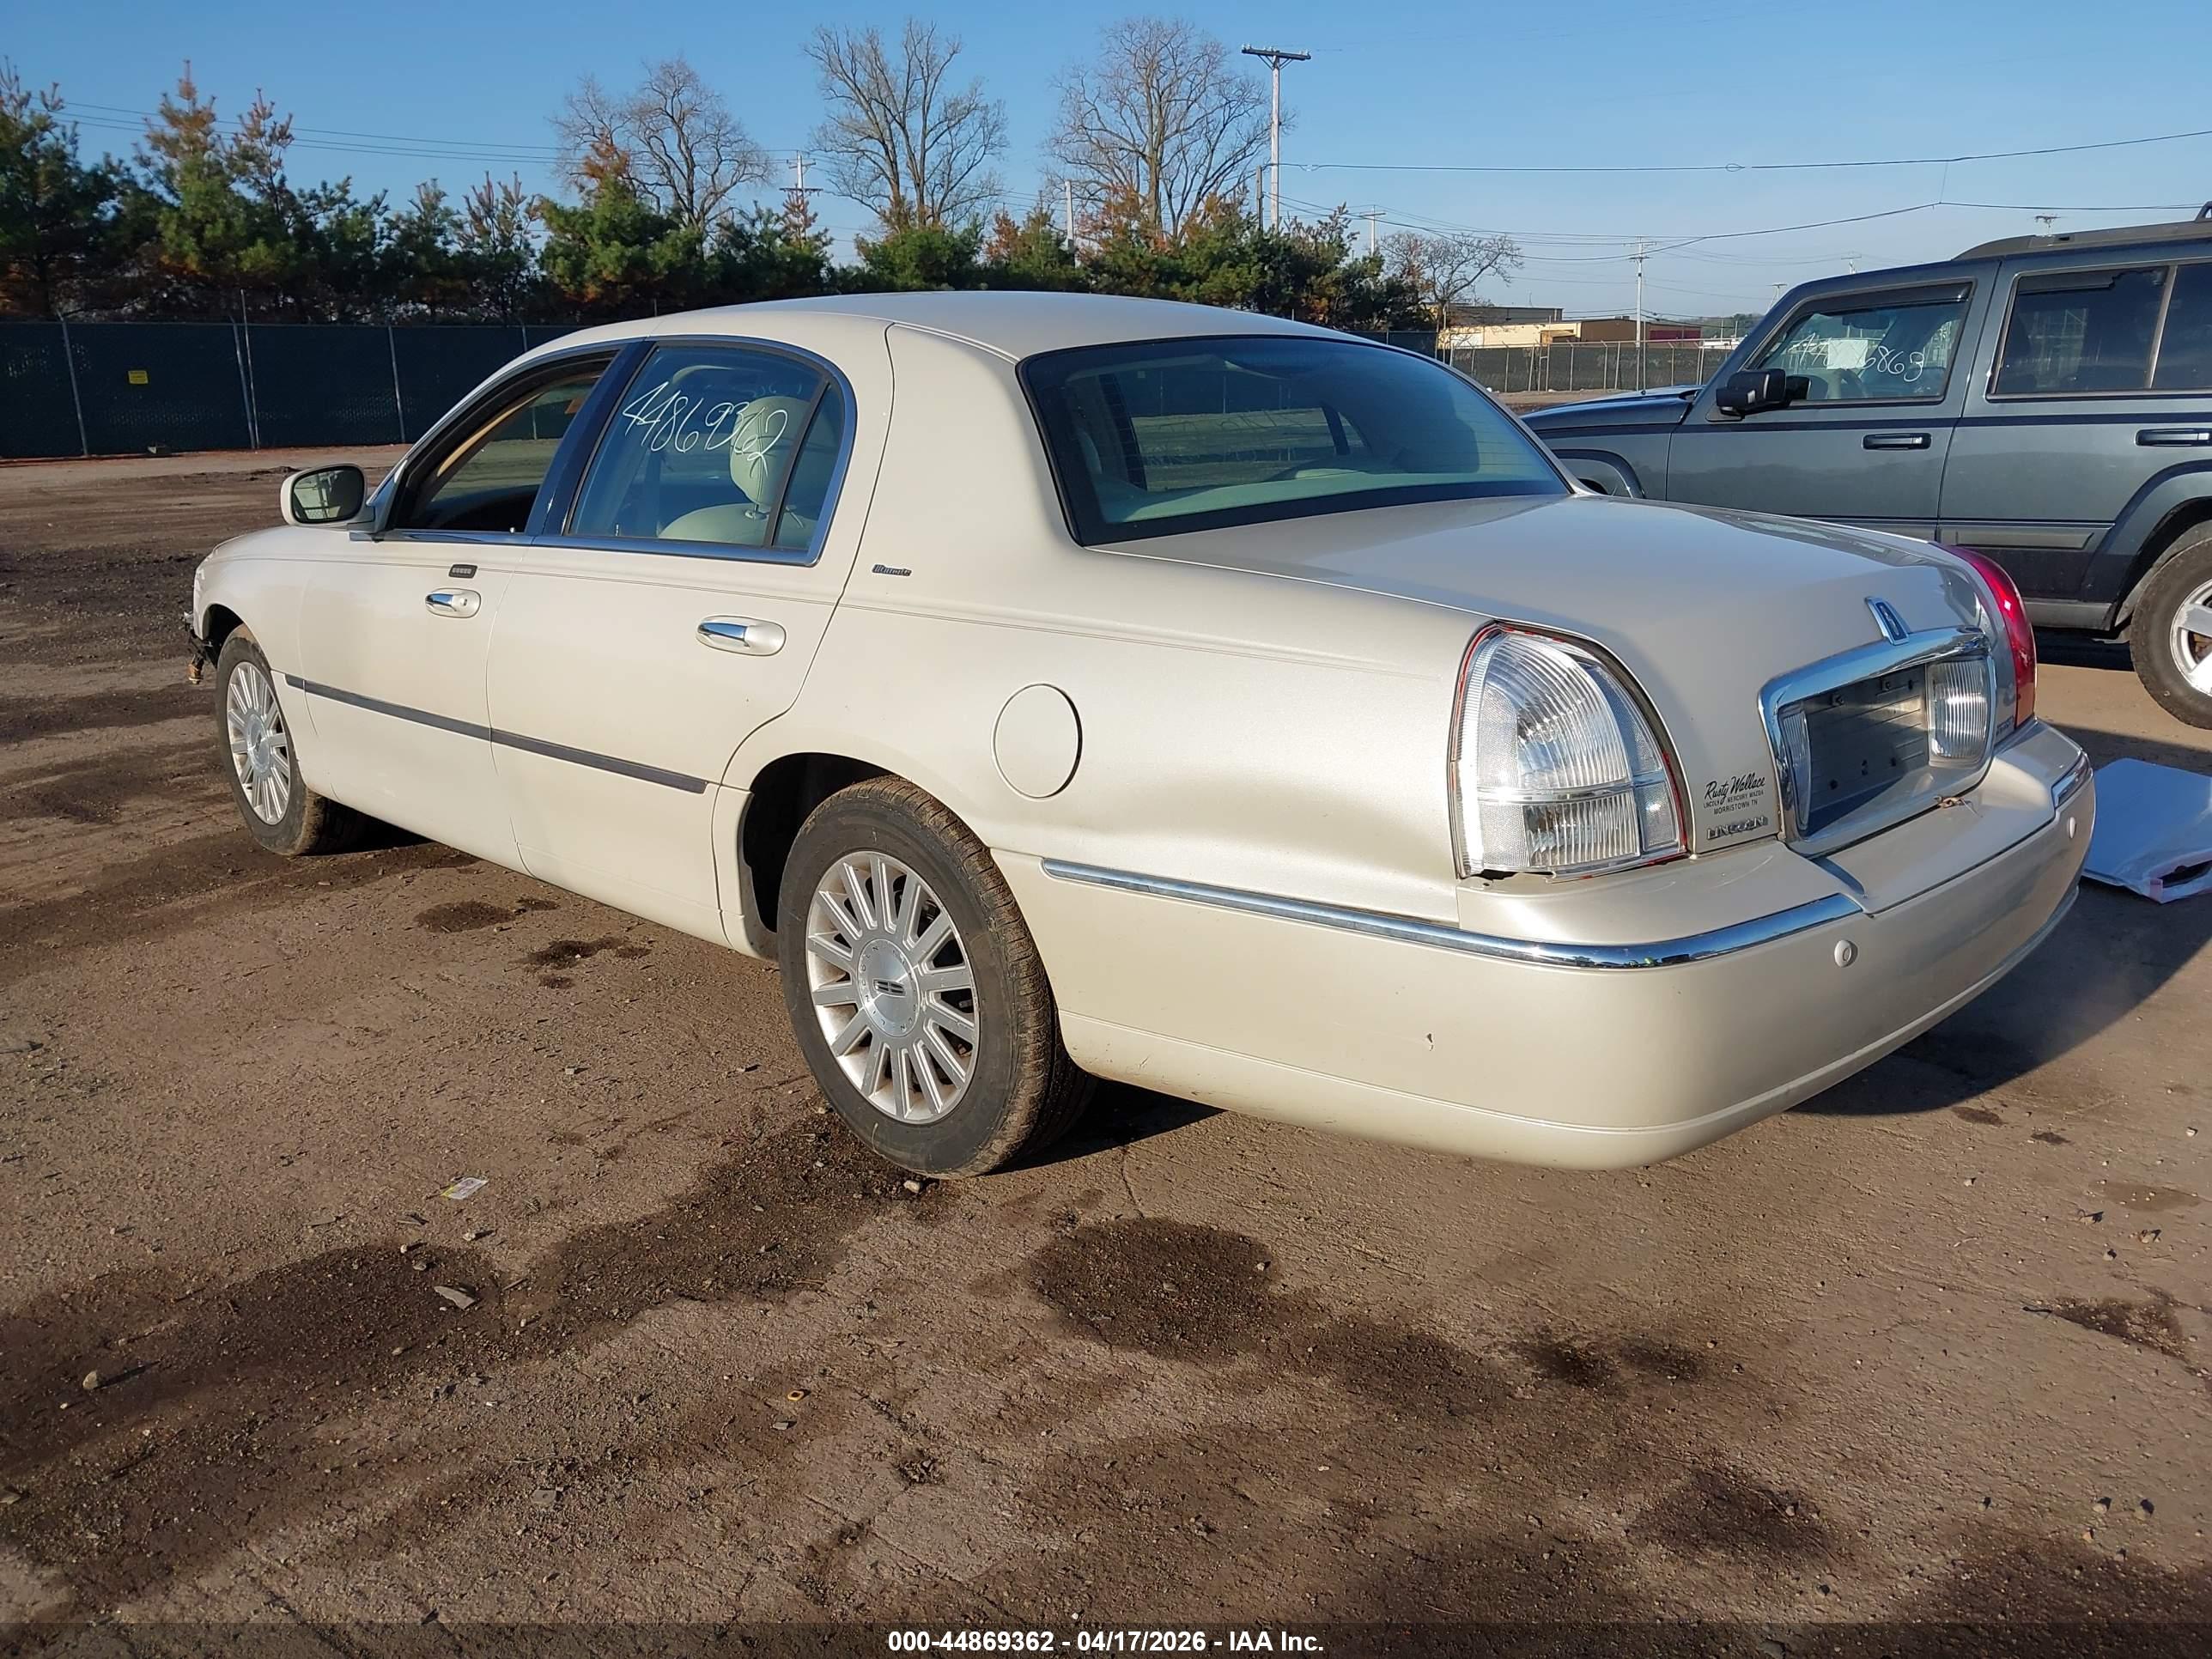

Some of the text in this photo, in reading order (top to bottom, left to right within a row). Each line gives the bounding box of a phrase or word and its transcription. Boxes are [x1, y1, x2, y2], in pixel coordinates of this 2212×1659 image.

[622, 380, 788, 477] 44869362
[1705, 772, 1765, 805] Rusty Wallace
[1714, 802, 1750, 815] MORRISTOWN
